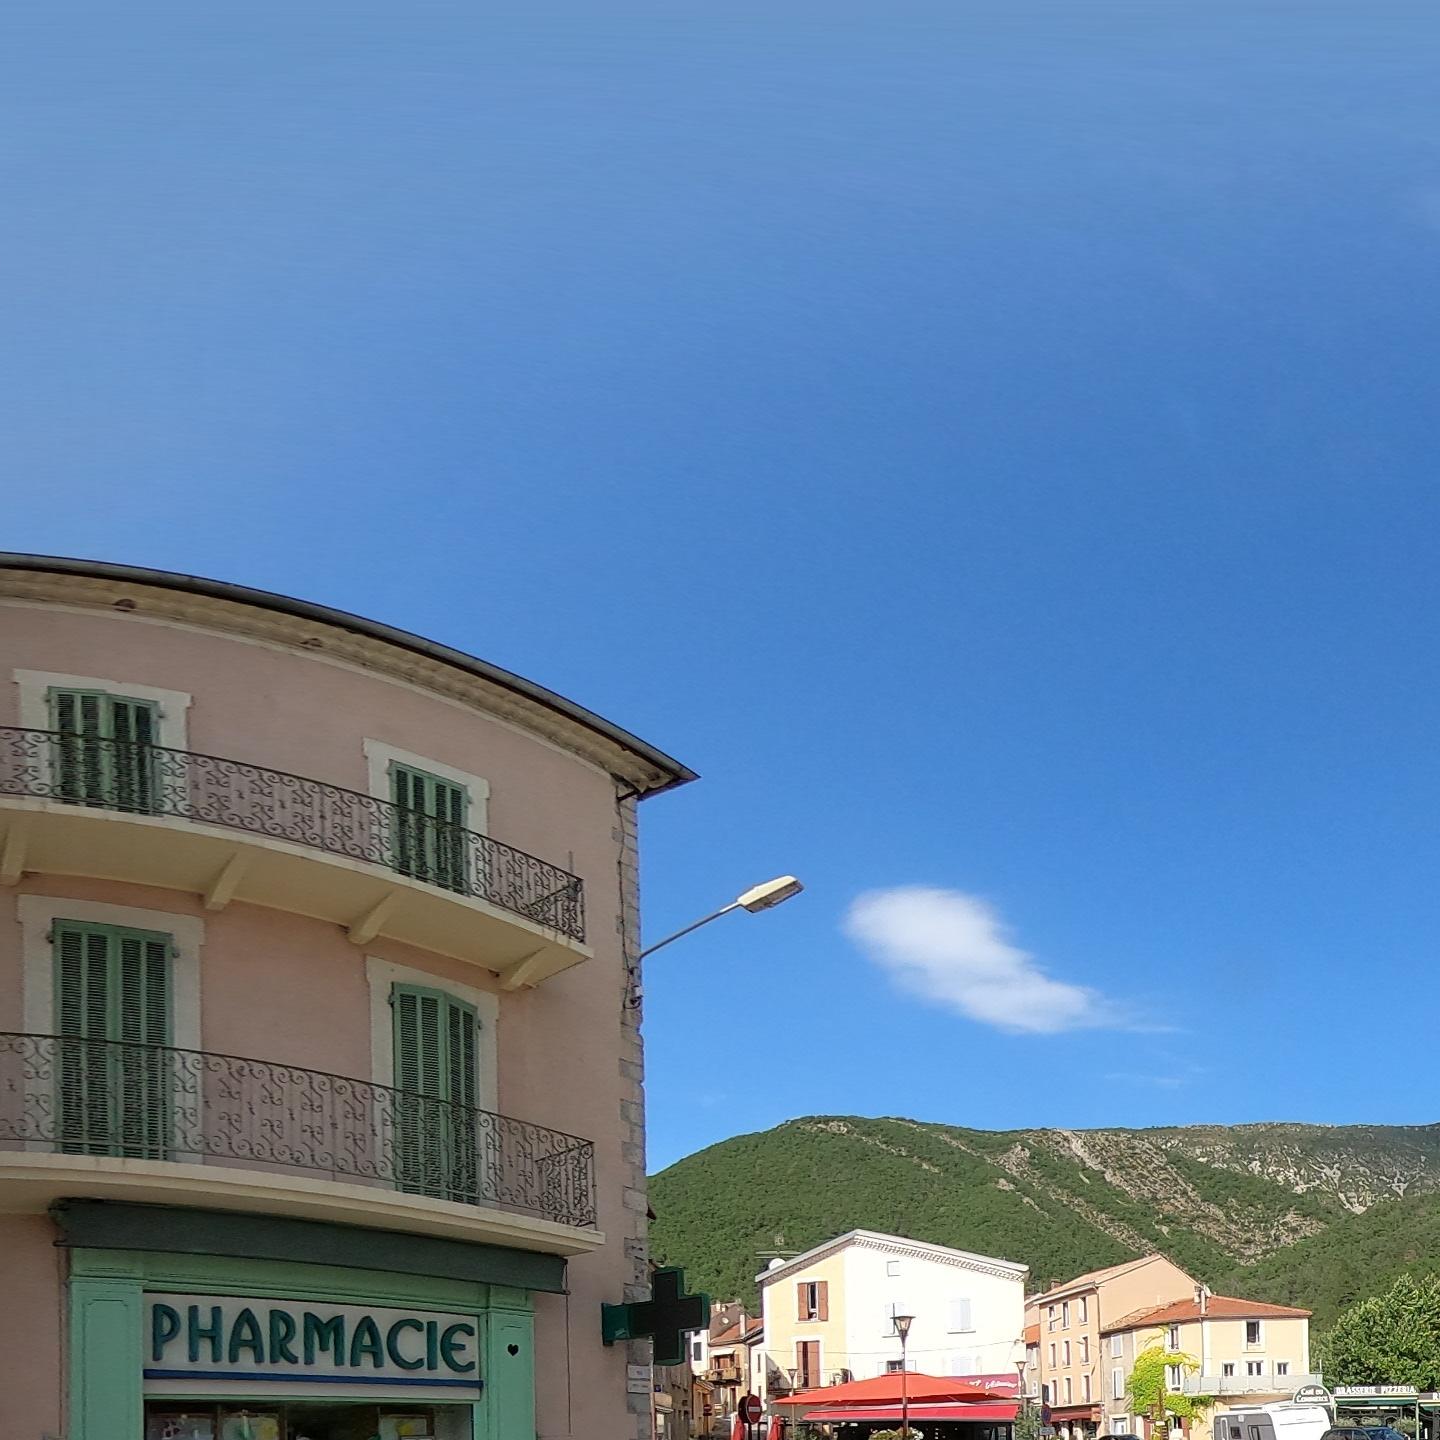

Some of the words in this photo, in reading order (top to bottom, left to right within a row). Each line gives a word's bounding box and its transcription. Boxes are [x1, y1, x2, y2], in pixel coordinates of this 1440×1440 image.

[152, 1303, 476, 1373] PHARMACIE
[1336, 1386, 1377, 1396] BRASSERIE
[1380, 1385, 1416, 1395] PIZZERIA
